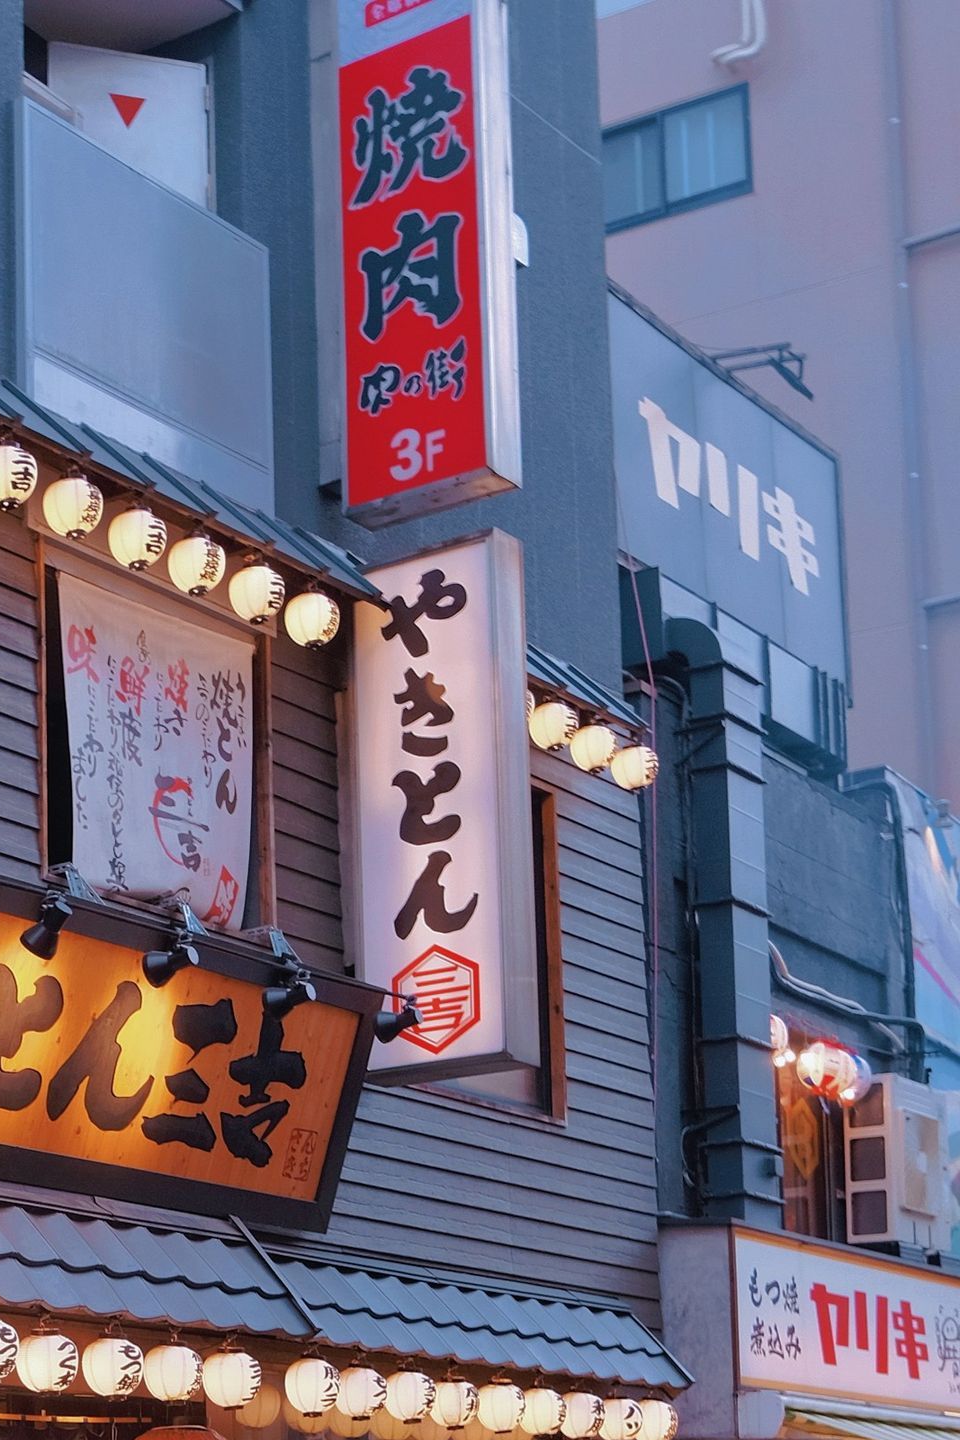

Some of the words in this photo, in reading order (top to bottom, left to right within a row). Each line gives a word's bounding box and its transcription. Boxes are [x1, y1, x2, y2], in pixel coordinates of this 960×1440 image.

[348, 66, 467, 345] 焼肉
[389, 427, 447, 483] 3F
[378, 567, 479, 942] やきとん
[750, 1316, 803, 1361] 煮込み
